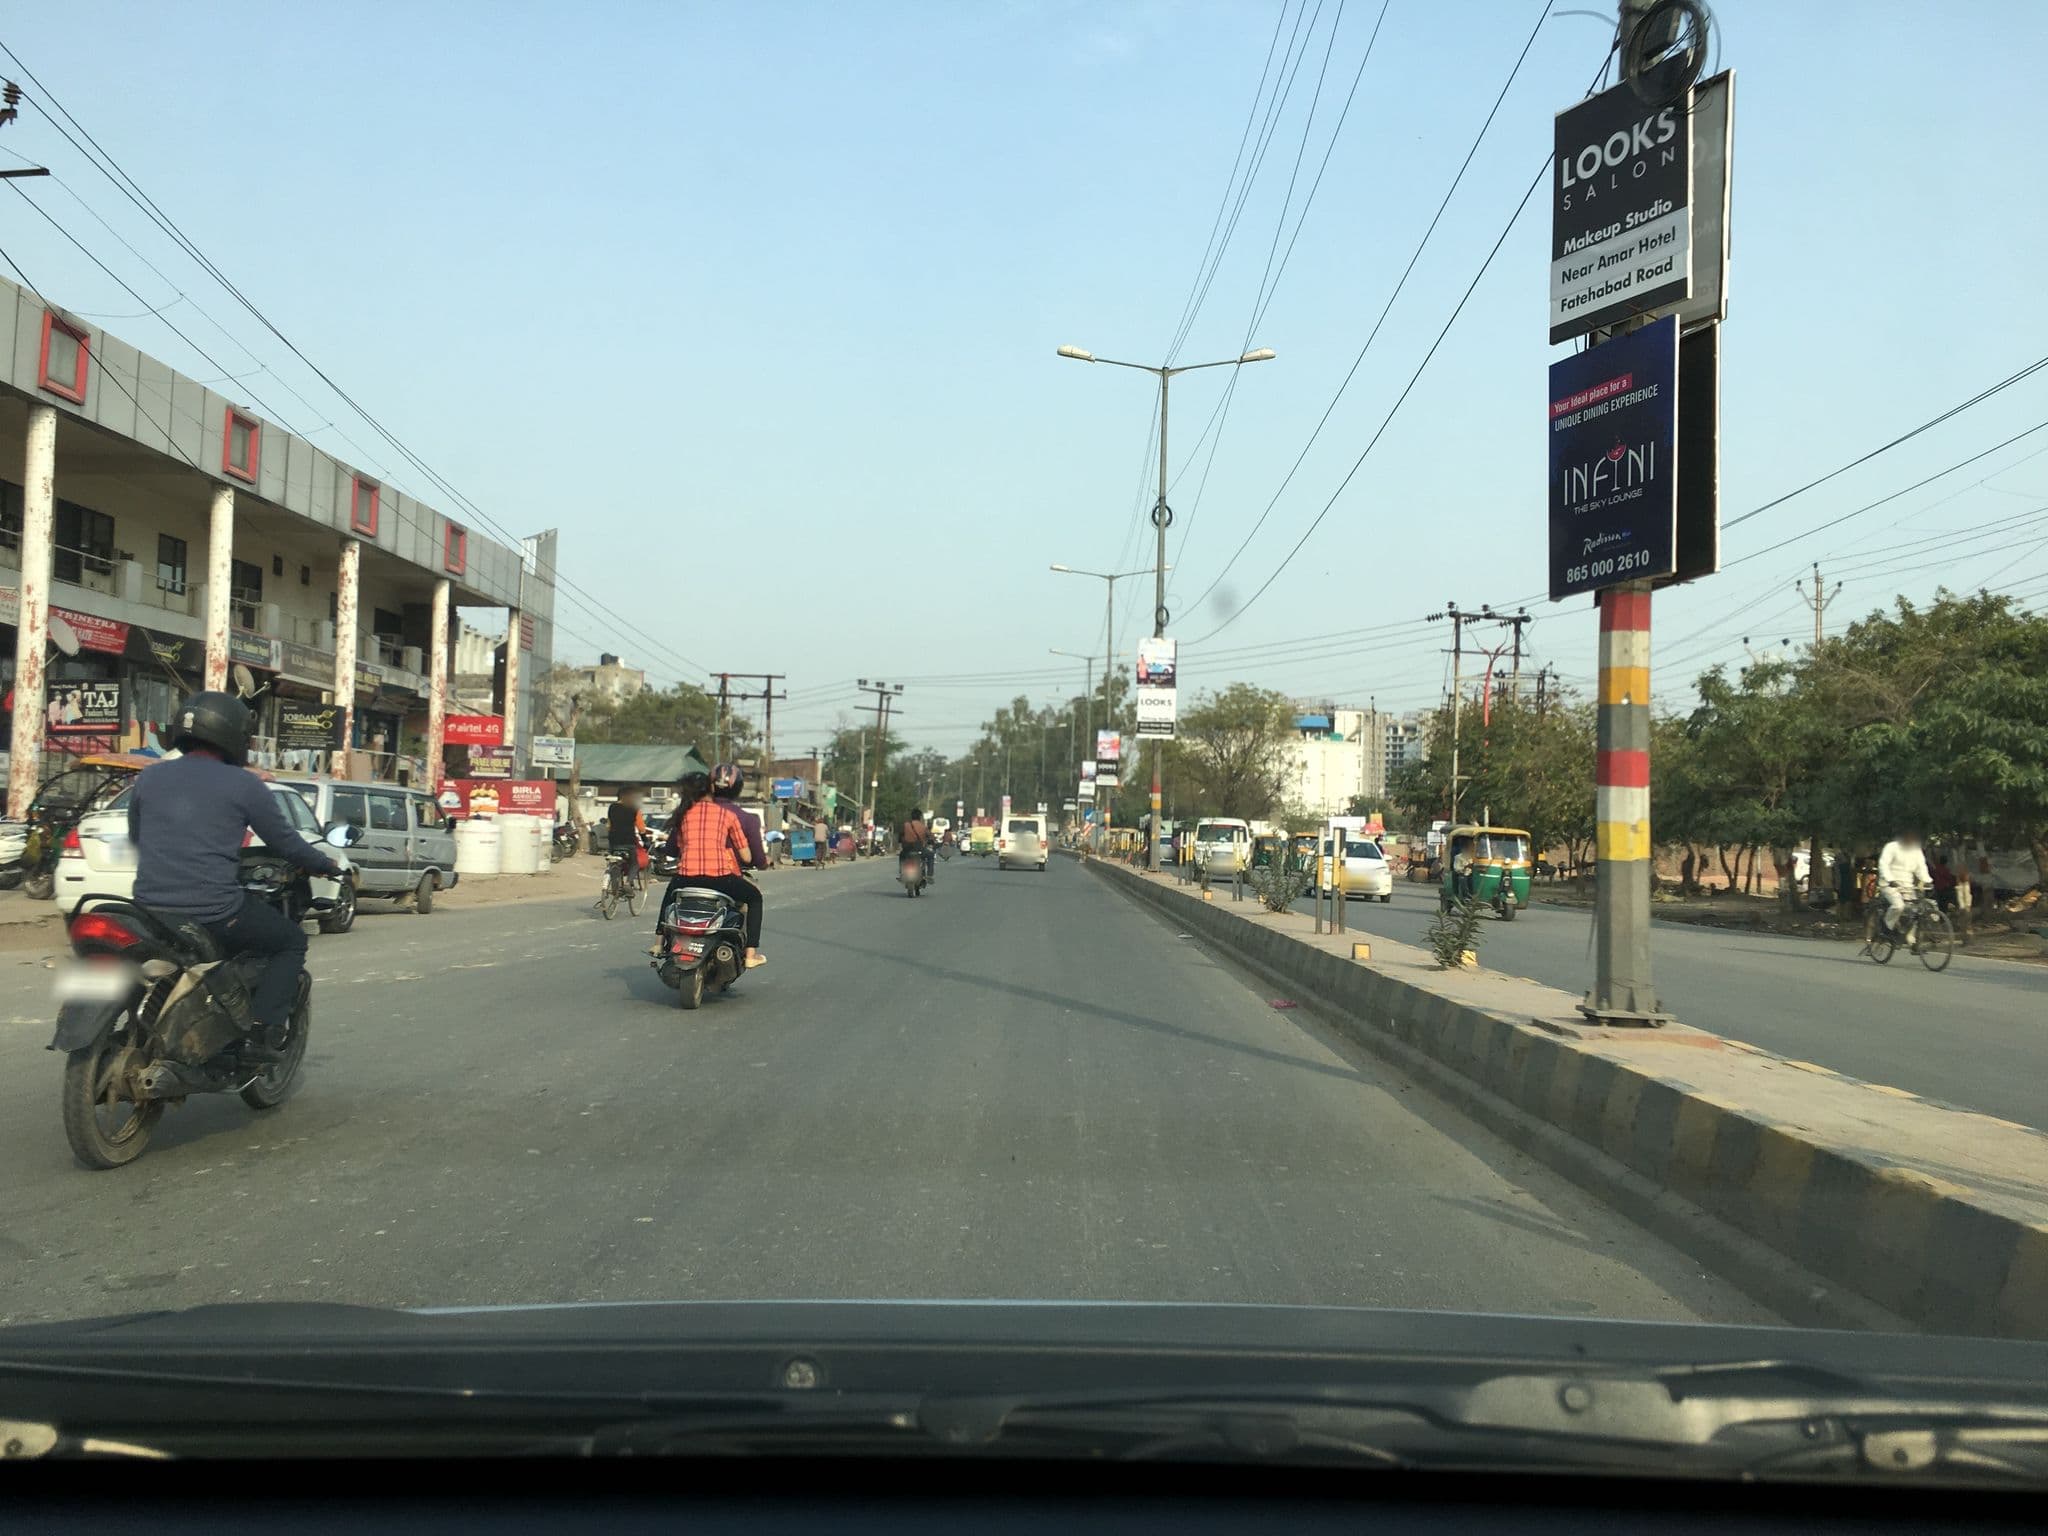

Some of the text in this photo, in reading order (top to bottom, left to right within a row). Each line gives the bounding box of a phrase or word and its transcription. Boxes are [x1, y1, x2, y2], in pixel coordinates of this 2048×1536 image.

[1562, 106, 1676, 189] LOOKS
[1563, 146, 1676, 211] SALON
[1563, 198, 1673, 255] Makeup Studio
[1561, 226, 1676, 285] Near Amar Hotel
[1560, 256, 1674, 312] Fatehabad Road
[1554, 400, 1570, 413] Your
[1589, 386, 1608, 402] place
[1609, 382, 1620, 392] for
[1621, 379, 1627, 388] a
[1554, 383, 1659, 432] UNIQUE DINING EXPERIENCE
[1563, 440, 1655, 506] INFINI
[1574, 488, 1643, 515] THE SKY LOUNGE
[1567, 549, 1650, 583] 865 000 2610
[57, 609, 117, 629] TRINETRA
[83, 691, 119, 708] TAJ
[1140, 698, 1172, 707] LOOKS
[283, 713, 320, 723] JORDAN
[457, 723, 499, 734] airtel 4G
[512, 786, 541, 794] BIRLA
